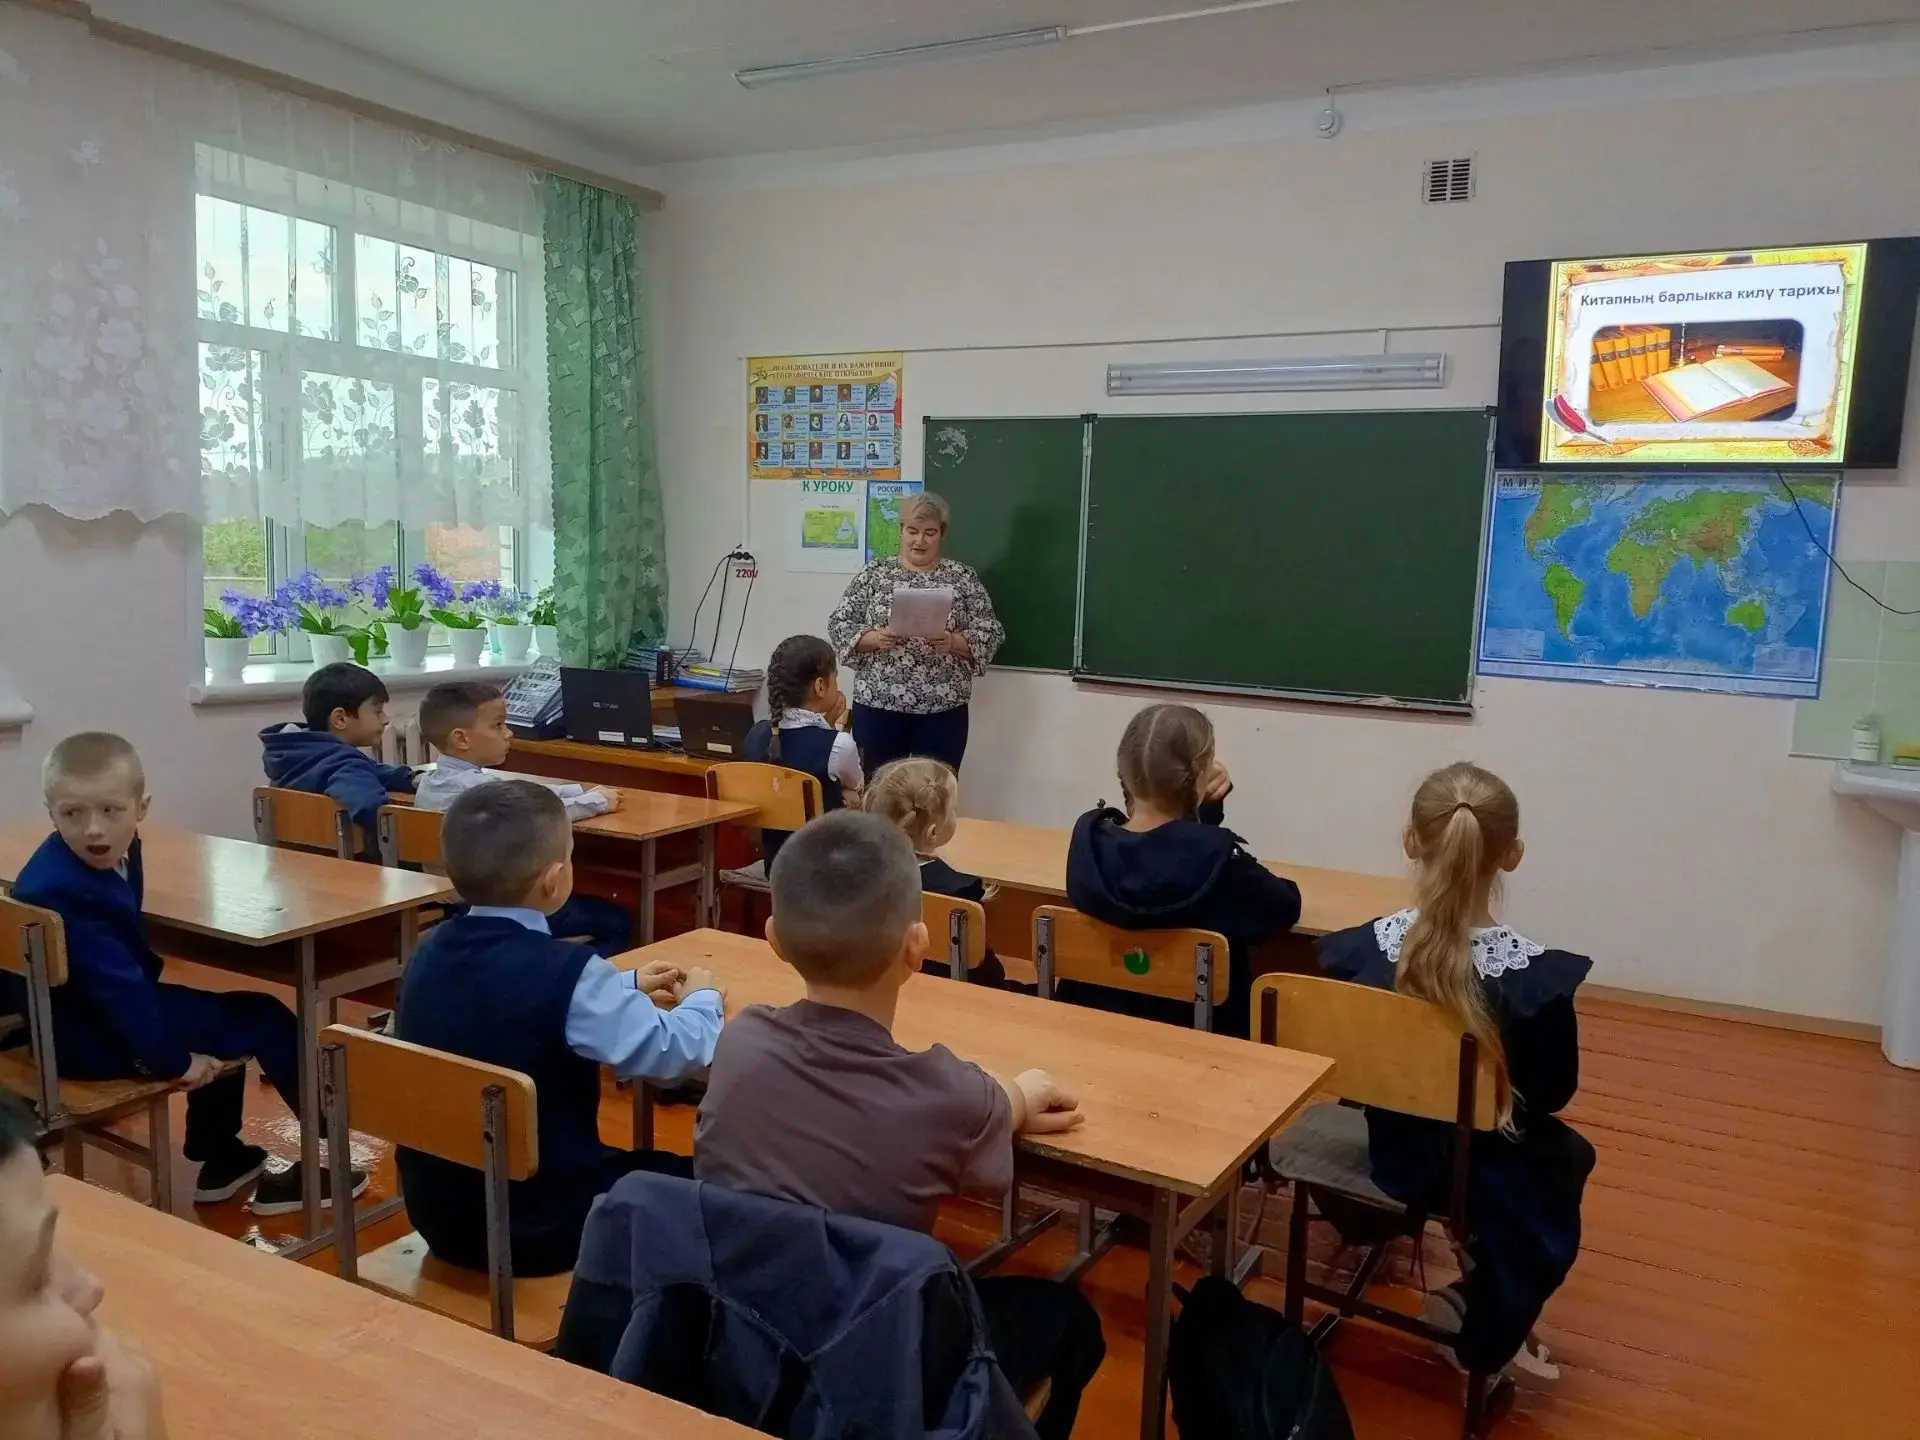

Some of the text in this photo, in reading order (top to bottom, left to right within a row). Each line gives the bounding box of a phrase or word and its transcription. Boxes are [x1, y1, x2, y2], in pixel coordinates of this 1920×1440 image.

[1580, 284, 1841, 307] Китапның барлыкка килү тарихы
[802, 480, 854, 493] К УРОКУ
[877, 485, 904, 493] РОССИЯ
